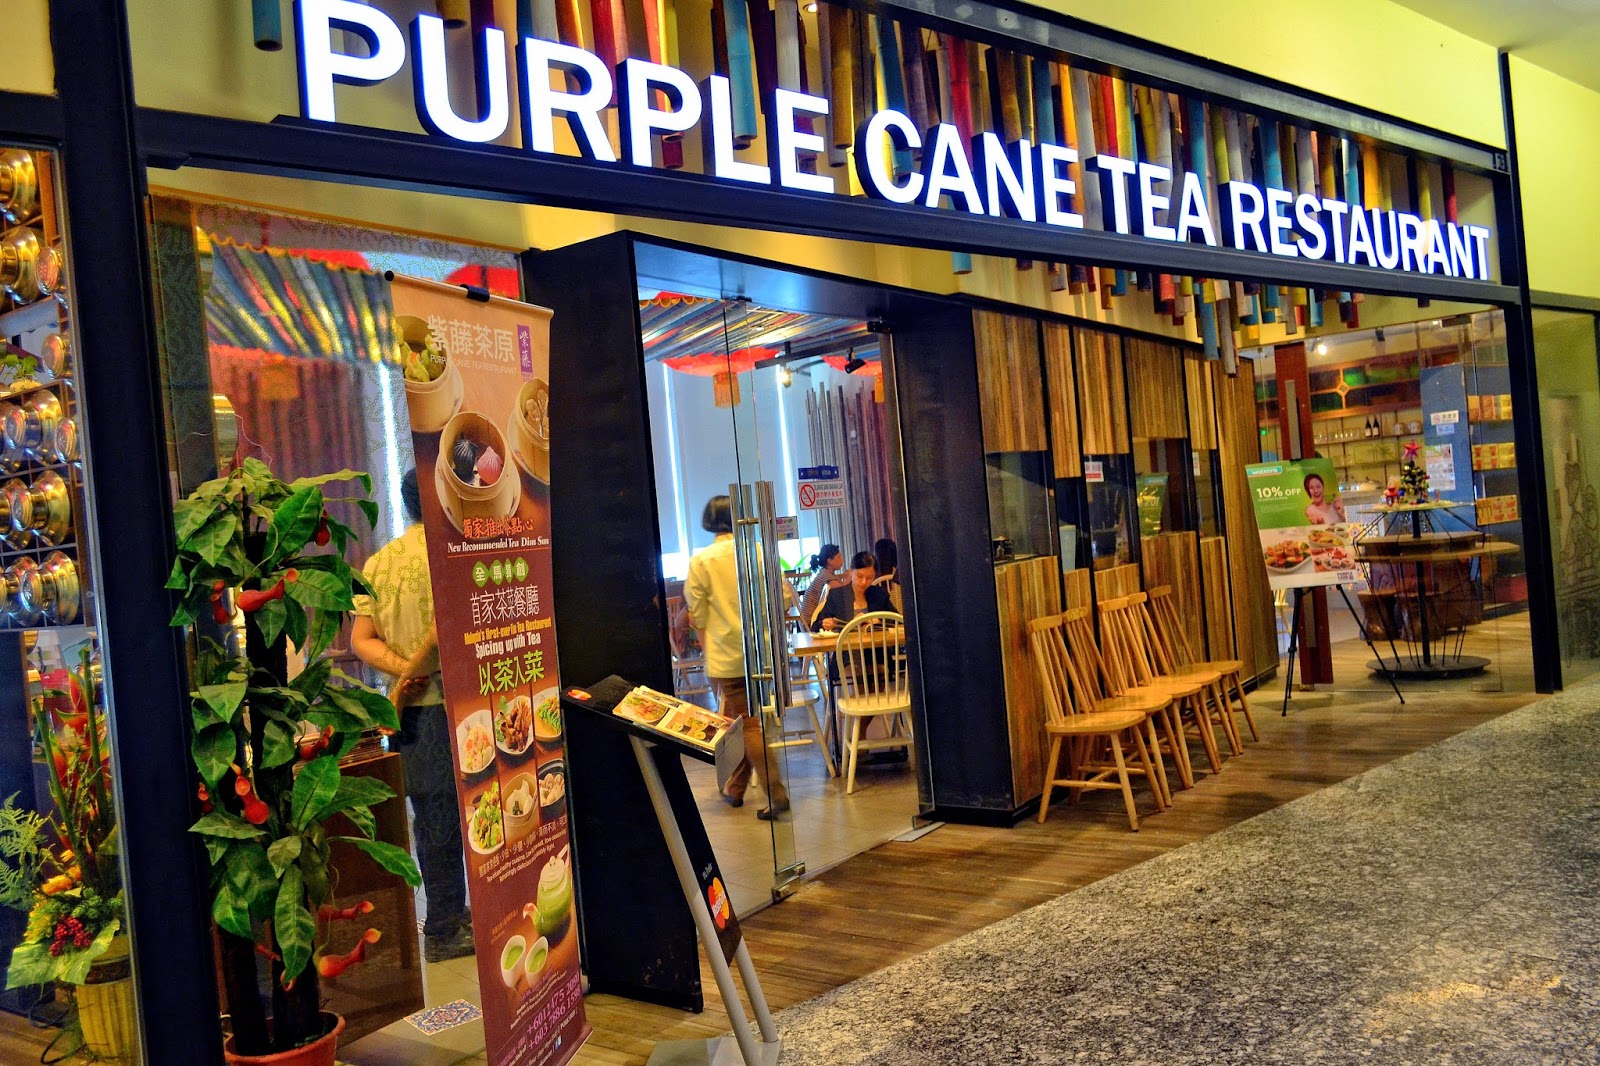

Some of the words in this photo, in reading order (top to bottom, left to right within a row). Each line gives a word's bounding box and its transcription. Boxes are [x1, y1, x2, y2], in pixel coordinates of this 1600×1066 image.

[297, 0, 836, 195] PURPLE
[858, 107, 1084, 229] CANE
[1093, 153, 1217, 247] TEA
[1226, 179, 1491, 281] RESTAURANT
[428, 314, 515, 362] 紫藤茶原
[1256, 486, 1283, 499] 10%
[1285, 488, 1302, 497] OFF
[447, 542, 461, 553] New
[508, 538, 519, 548] Tea
[521, 537, 536, 547] Dim
[537, 536, 549, 546] Sum
[525, 617, 552, 631] Restaurant
[475, 640, 504, 659] Spicing
[513, 635, 526, 649] with
[527, 632, 541, 646] Tea
[479, 650, 545, 697] 以茶入菜
